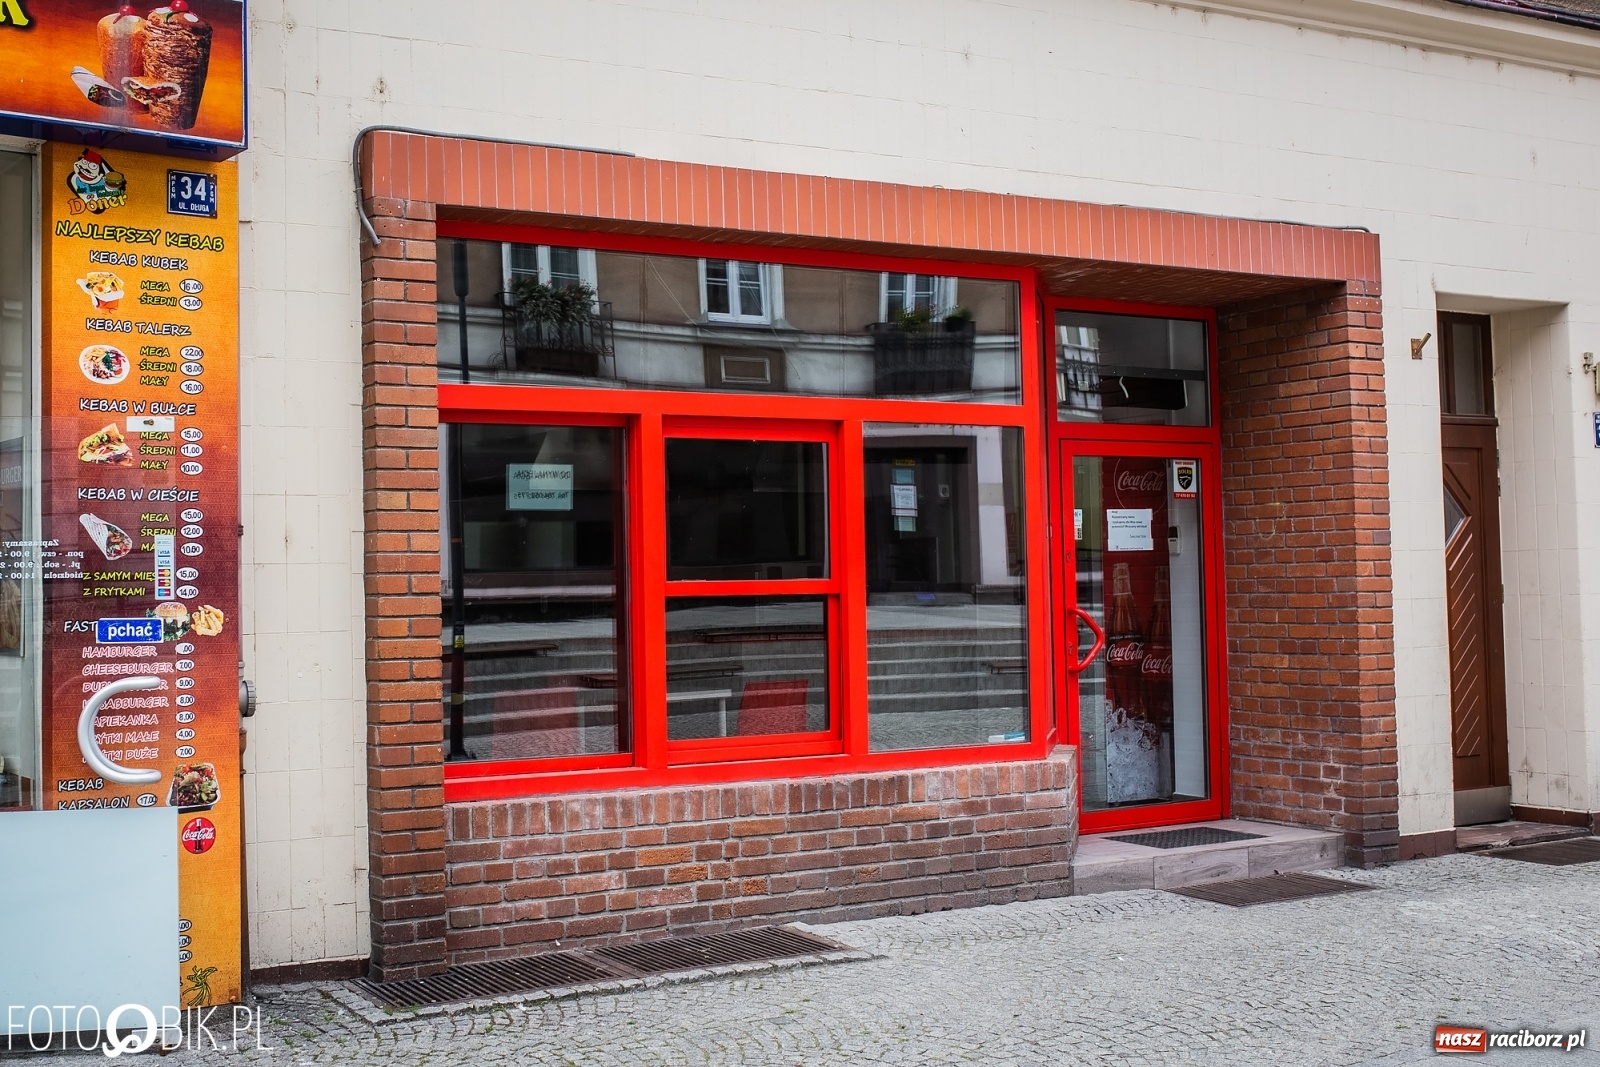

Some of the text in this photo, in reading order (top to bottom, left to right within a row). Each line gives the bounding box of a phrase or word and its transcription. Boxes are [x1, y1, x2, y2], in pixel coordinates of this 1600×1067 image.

[180, 176, 207, 202] 34
[178, 202, 210, 212] UL. DŁUGA
[56, 221, 225, 251] NAJLEPSZY KEBAB
[90, 250, 188, 270] KEBAB KUBEK
[140, 281, 170, 292] MEGA
[140, 293, 177, 307] ŚREDNI
[86, 318, 192, 336] KEBAB TALERZ
[140, 346, 170, 357] MEGA
[140, 359, 177, 373] ŚREDNI
[140, 375, 170, 386] MAŁY
[79, 398, 197, 416] KEBAB W BUŁCE
[140, 431, 170, 441] MEGA
[140, 443, 177, 456] ŚREDNI
[140, 460, 170, 471] MAŁY
[1117, 470, 1165, 491] Coca-Cola
[78, 487, 199, 502] KEBAB W CIEŚCIE
[140, 513, 170, 523] MEGA
[140, 526, 177, 537] ŚREDNI
[140, 542, 156, 552] MA
[83, 572, 91, 581] Z
[94, 571, 131, 581] SAMYM
[83, 587, 146, 597] Z FRYTKAMI
[64, 620, 96, 633] FAST
[107, 621, 153, 640] pchać
[82, 645, 158, 658] HAMBURGER
[1107, 641, 1145, 662] Coca-Cola
[82, 662, 174, 675] CHEESEBURGER
[93, 713, 158, 727] APIEKANKA
[125, 731, 160, 743] MAŁE
[126, 748, 159, 760] DUŻE
[58, 778, 104, 792] KEBAB
[58, 796, 130, 810] KAPSALON
[182, 826, 215, 842] Coca-Cola
